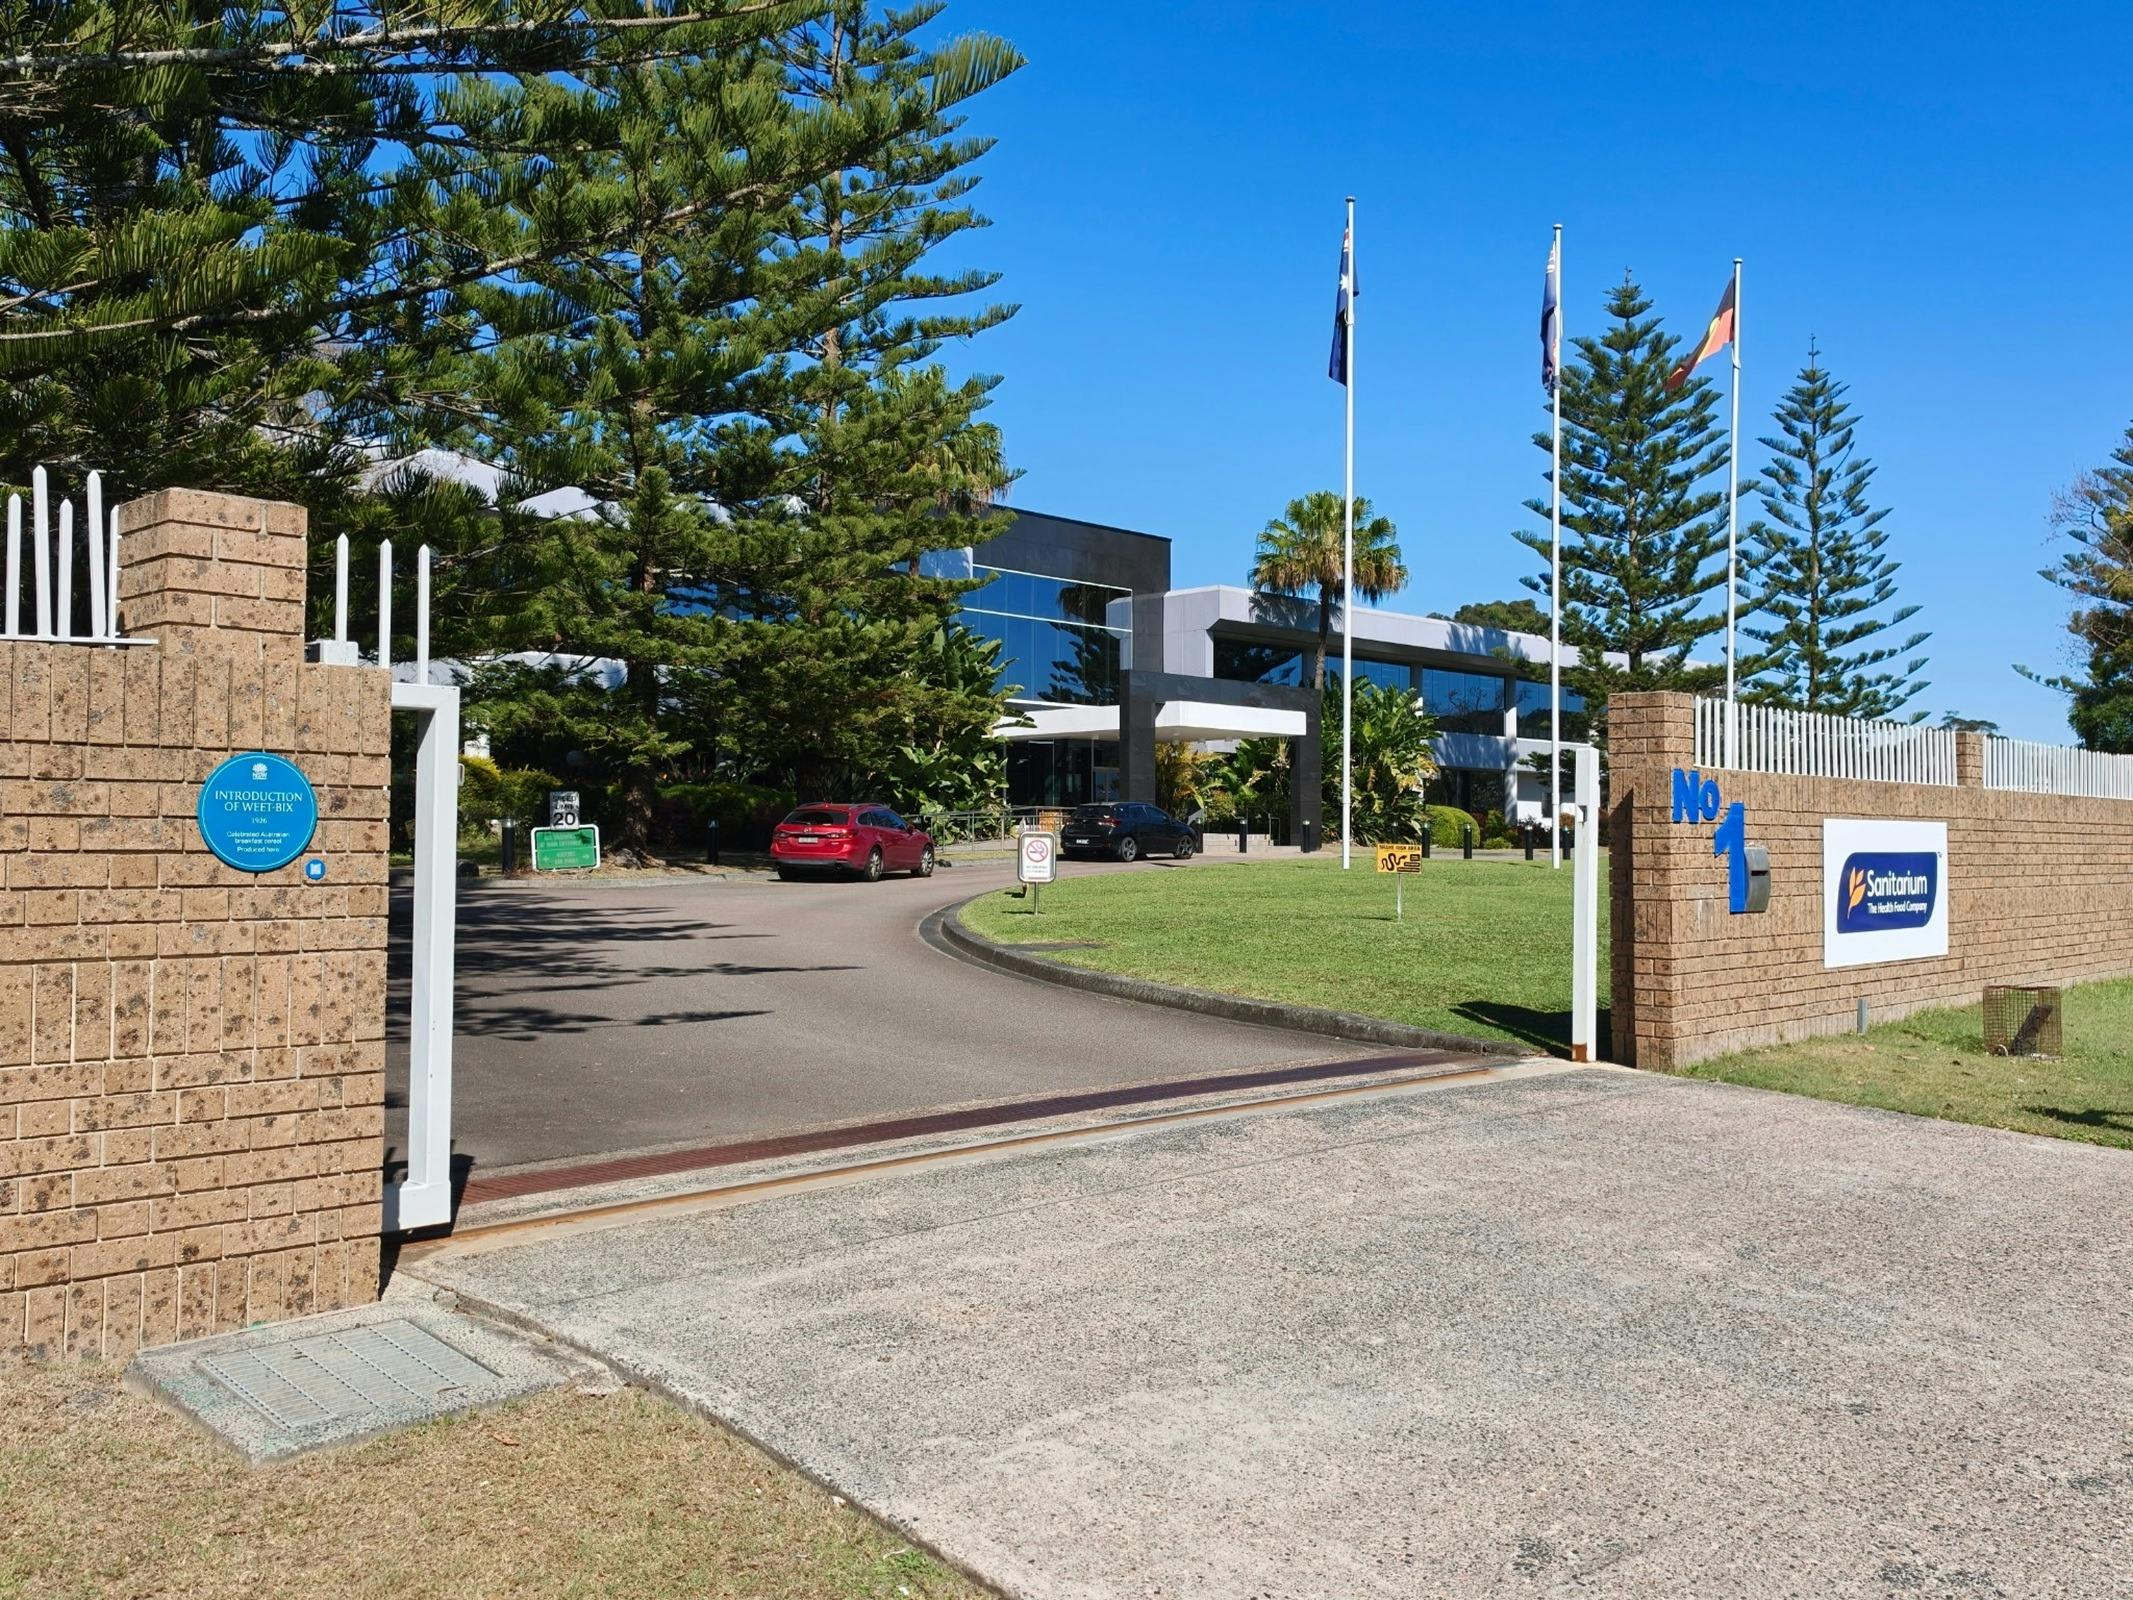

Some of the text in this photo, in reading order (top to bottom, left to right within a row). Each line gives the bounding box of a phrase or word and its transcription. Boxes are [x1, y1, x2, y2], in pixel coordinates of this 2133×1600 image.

[215, 790, 303, 802] INTRODUCTION
[224, 801, 240, 812] OF
[553, 812, 576, 826] 20
[1867, 869, 1928, 897] Sanitarium
[1867, 900, 1928, 914] The Health Food Company
